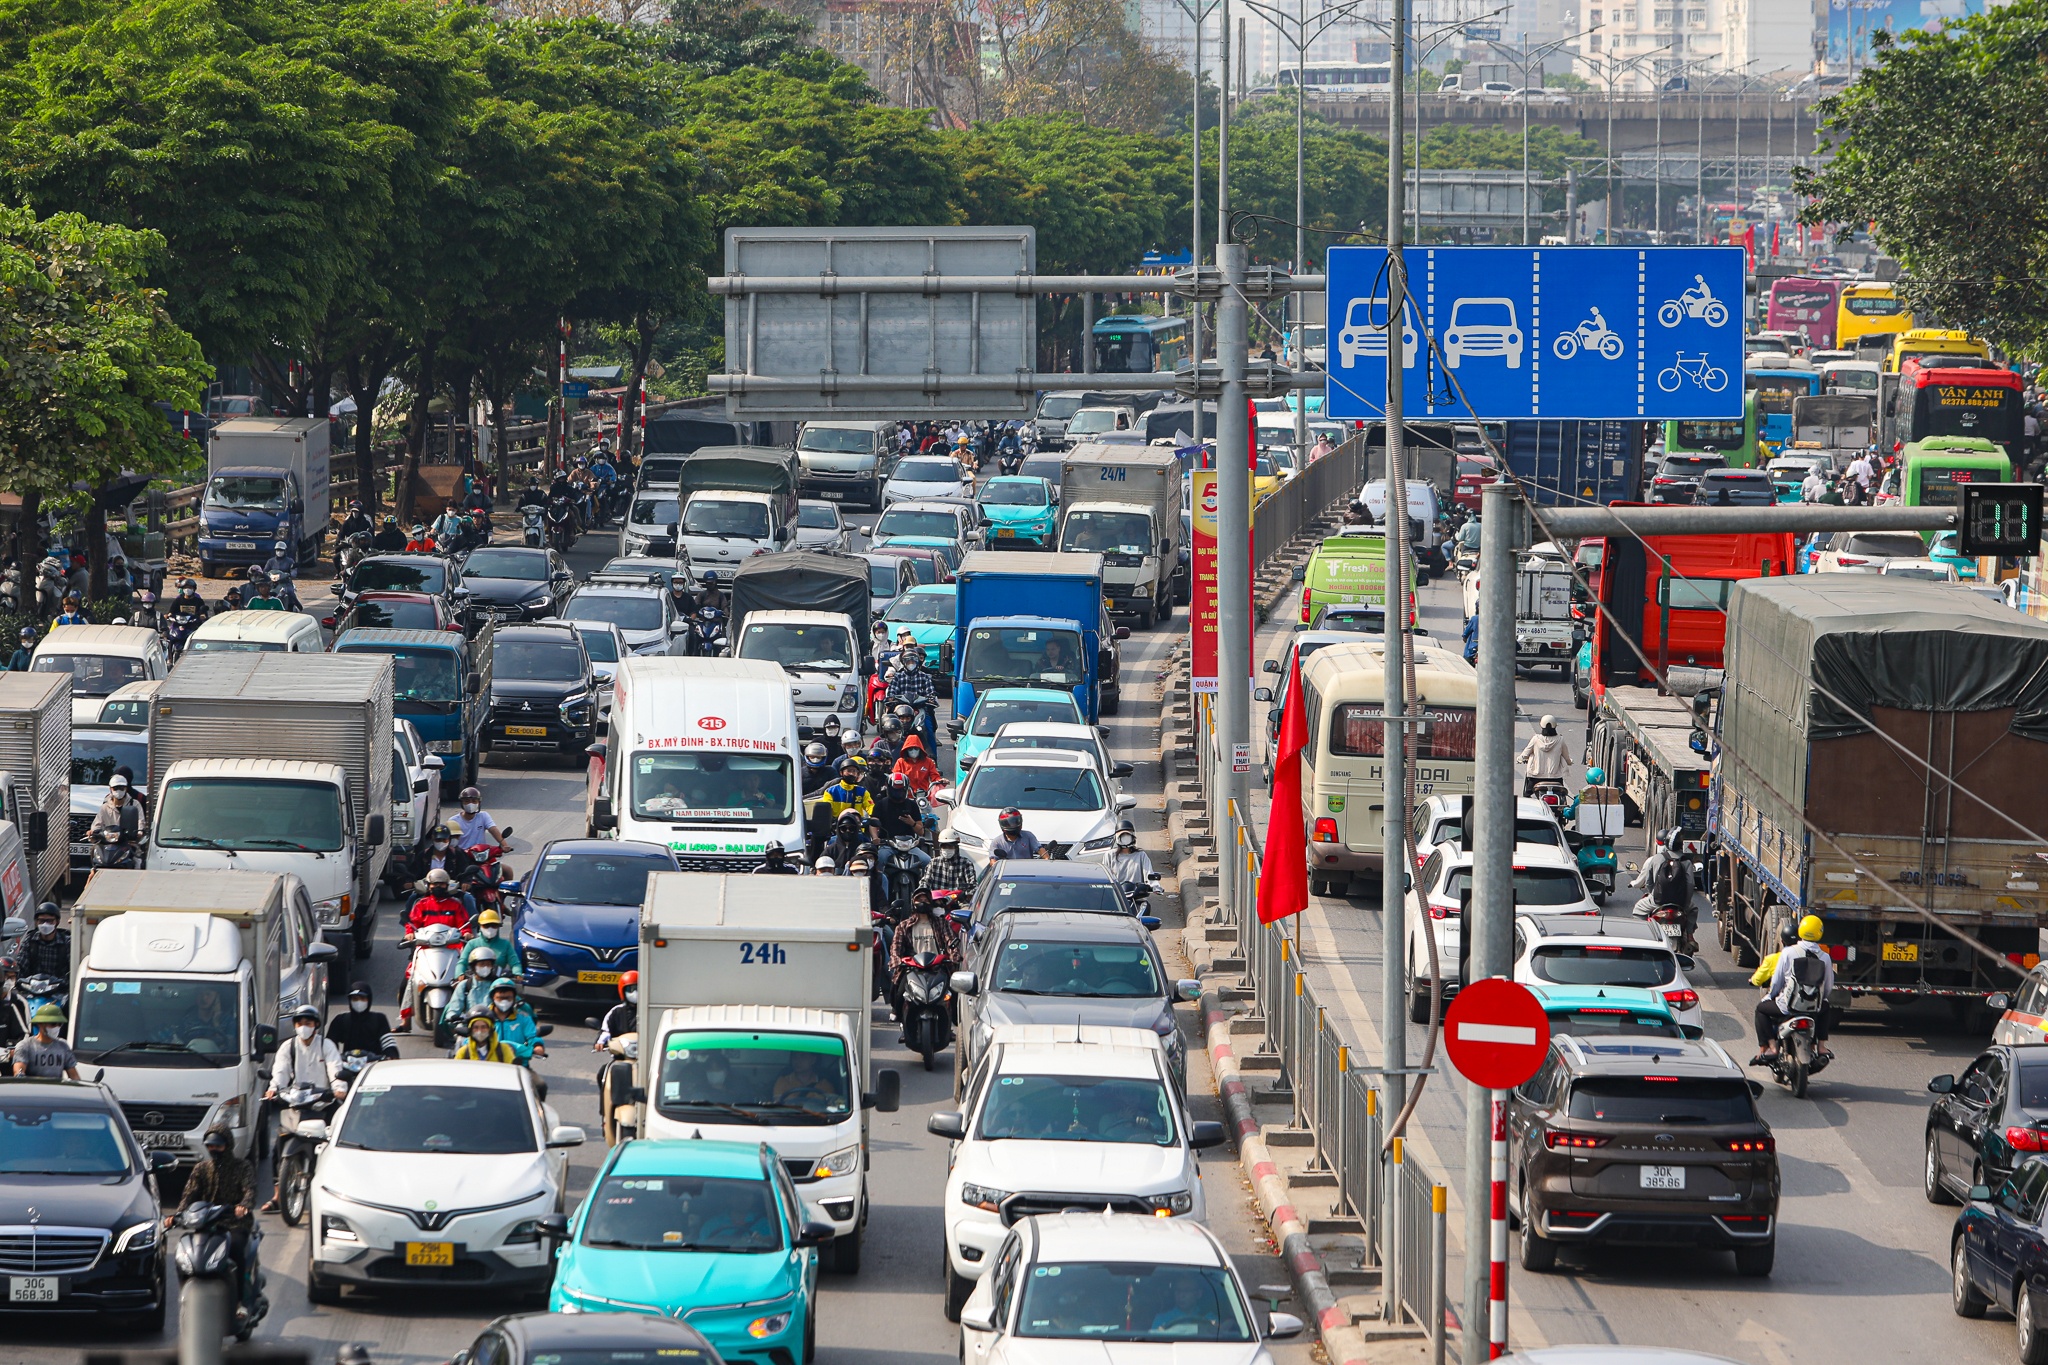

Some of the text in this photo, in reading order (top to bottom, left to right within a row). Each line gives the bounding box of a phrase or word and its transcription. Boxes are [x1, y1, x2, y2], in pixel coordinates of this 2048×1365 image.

[1938, 386, 2004, 398] VÂN ANH
[1100, 466, 1126, 482] 24/H
[1206, 545, 1218, 555] THẮ
[1342, 563, 1386, 573] Fresh Foo
[1199, 573, 1215, 581] TRANG
[1201, 611, 1208, 620] VÀ
[1195, 679, 1213, 688] QUẬN
[702, 719, 723, 728] 215
[681, 736, 704, 747] ĐÌNH
[710, 737, 750, 750] BX.TRỰC
[753, 739, 776, 751] NINH
[689, 843, 718, 852] LONG
[725, 843, 744, 854] ĐẠI
[745, 844, 765, 852] DUY
[739, 941, 786, 964] 24h
[1887, 952, 1914, 961] 100.72
[35, 1053, 62, 1067] ICON
[1621, 1144, 1706, 1152] TERRITORY
[1653, 1167, 1672, 1177] 30K
[1645, 1178, 1680, 1188] 385.86
[420, 1242, 441, 1253] 29H
[24, 1278, 46, 1289] 30G
[15, 1289, 54, 1301] 568.38
